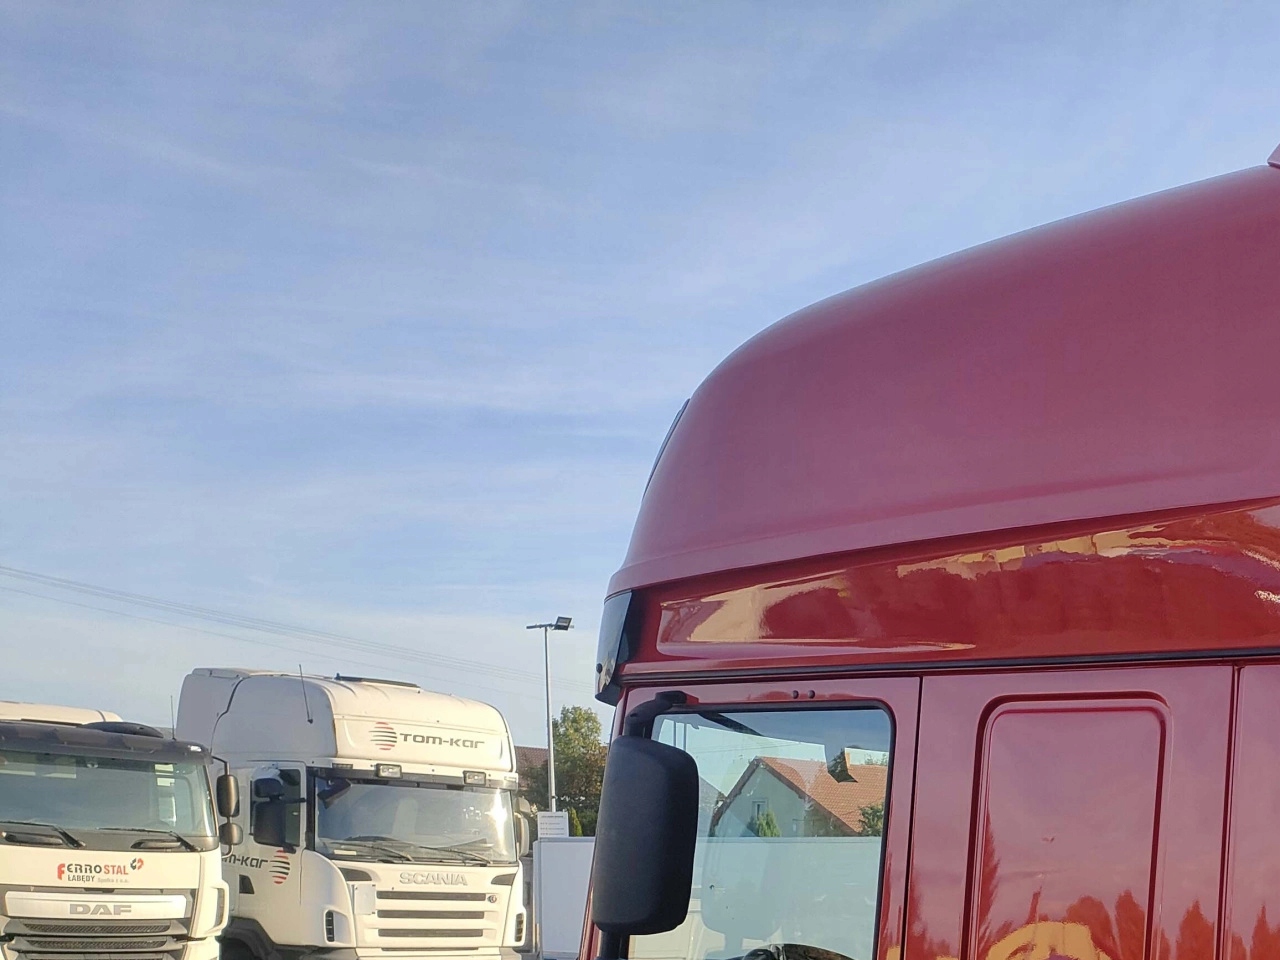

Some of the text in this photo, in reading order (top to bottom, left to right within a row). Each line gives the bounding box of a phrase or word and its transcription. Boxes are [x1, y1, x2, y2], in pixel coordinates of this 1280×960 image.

[67, 874, 95, 883] ŁABĘDY
[399, 871, 468, 887] SCANIA
[69, 903, 132, 916] DAF
